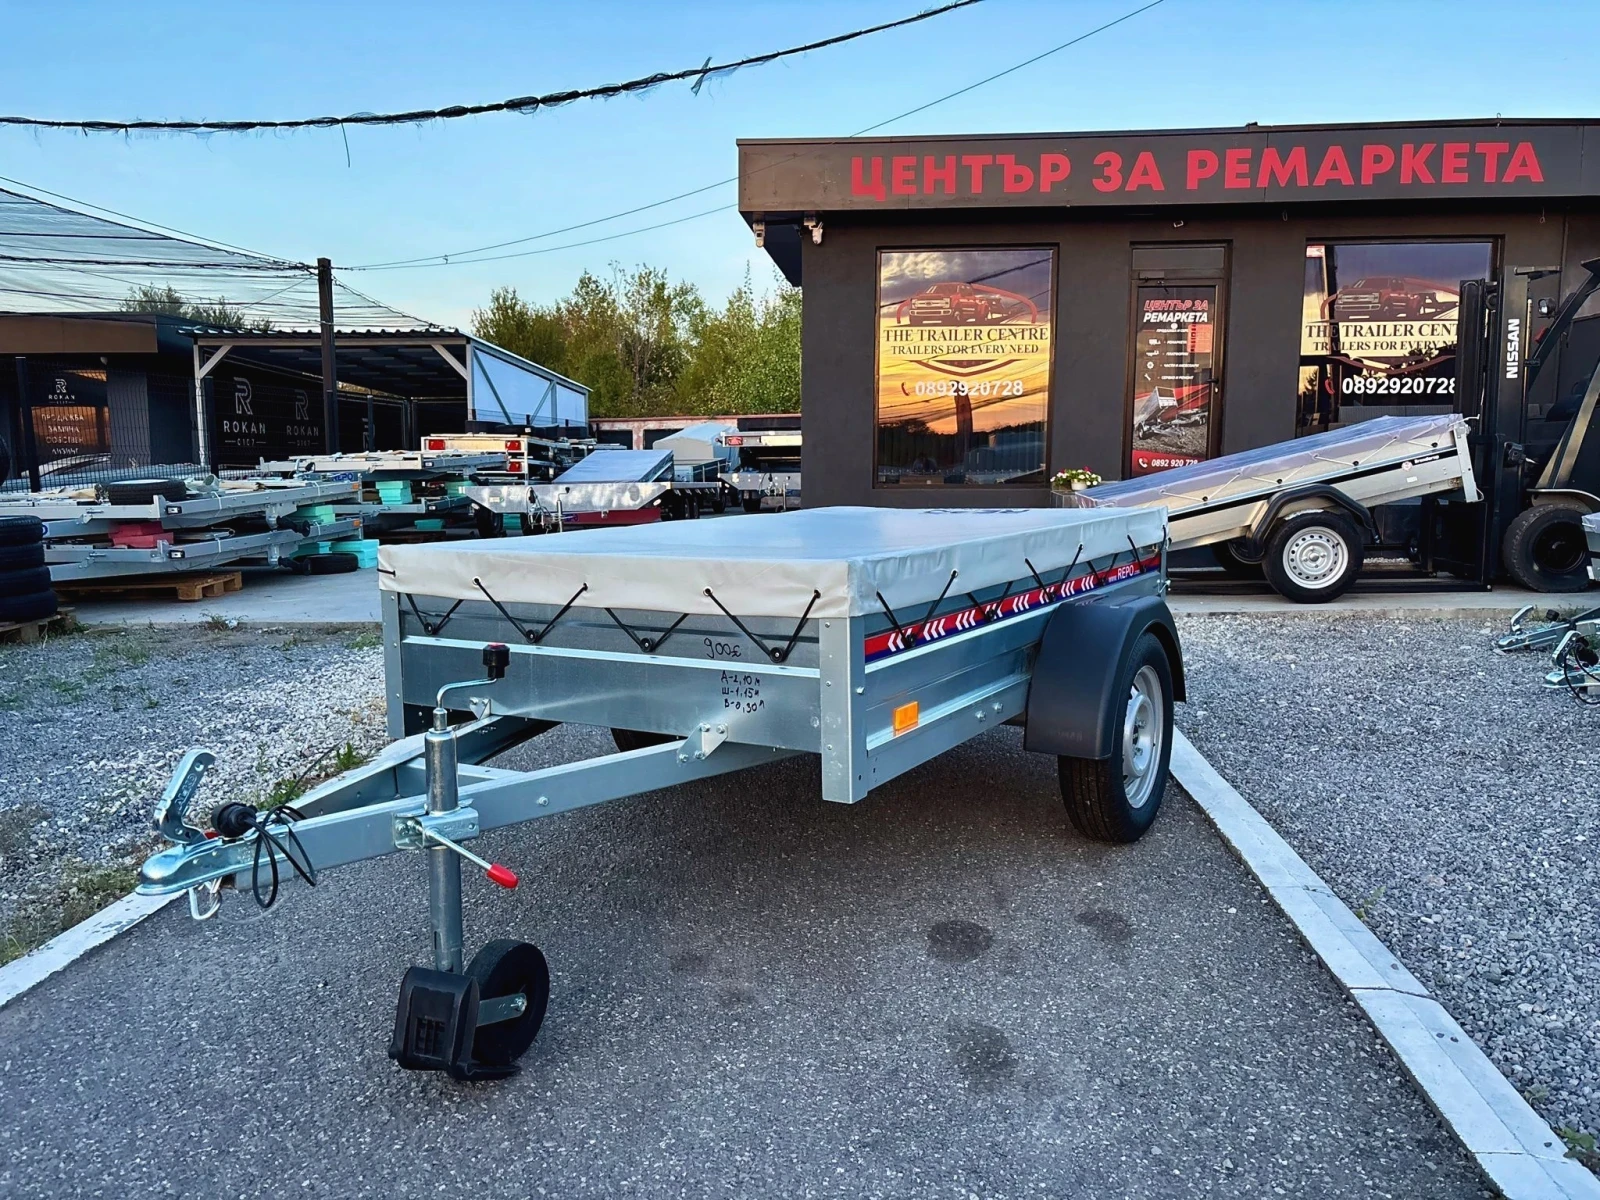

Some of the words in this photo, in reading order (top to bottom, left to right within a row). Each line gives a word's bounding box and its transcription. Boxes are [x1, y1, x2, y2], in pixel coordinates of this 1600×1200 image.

[851, 154, 1071, 202] ЦЕНТЪР
[1092, 151, 1164, 193] ЗА
[1186, 142, 1544, 190] РЕМАРКЕТА
[1144, 300, 1192, 312] ЦЕНТЪР
[1192, 300, 1209, 311] ЗА
[1143, 312, 1208, 323] РЕМАРКЕТА
[883, 330, 914, 342] THE
[917, 329, 983, 342] TRAILER
[987, 328, 1048, 341] CENTRE
[1305, 325, 1339, 338] THE
[1342, 324, 1415, 337] TRAILER
[891, 345, 944, 355] TRAILERS
[947, 345, 969, 354] FOR
[971, 344, 1006, 354] EVERY
[1009, 344, 1039, 354] NEED
[1313, 341, 1371, 351] TRAILERS
[1373, 341, 1398, 351] FOR
[1400, 340, 1440, 350] EVERY
[1506, 318, 1520, 379] NISSAN
[915, 380, 1023, 397] 0892920728
[223, 420, 266, 435] ROKAN
[286, 425, 319, 437] ROKAN
[1151, 459, 1169, 467] 0892
[1170, 459, 1184, 467] 920
